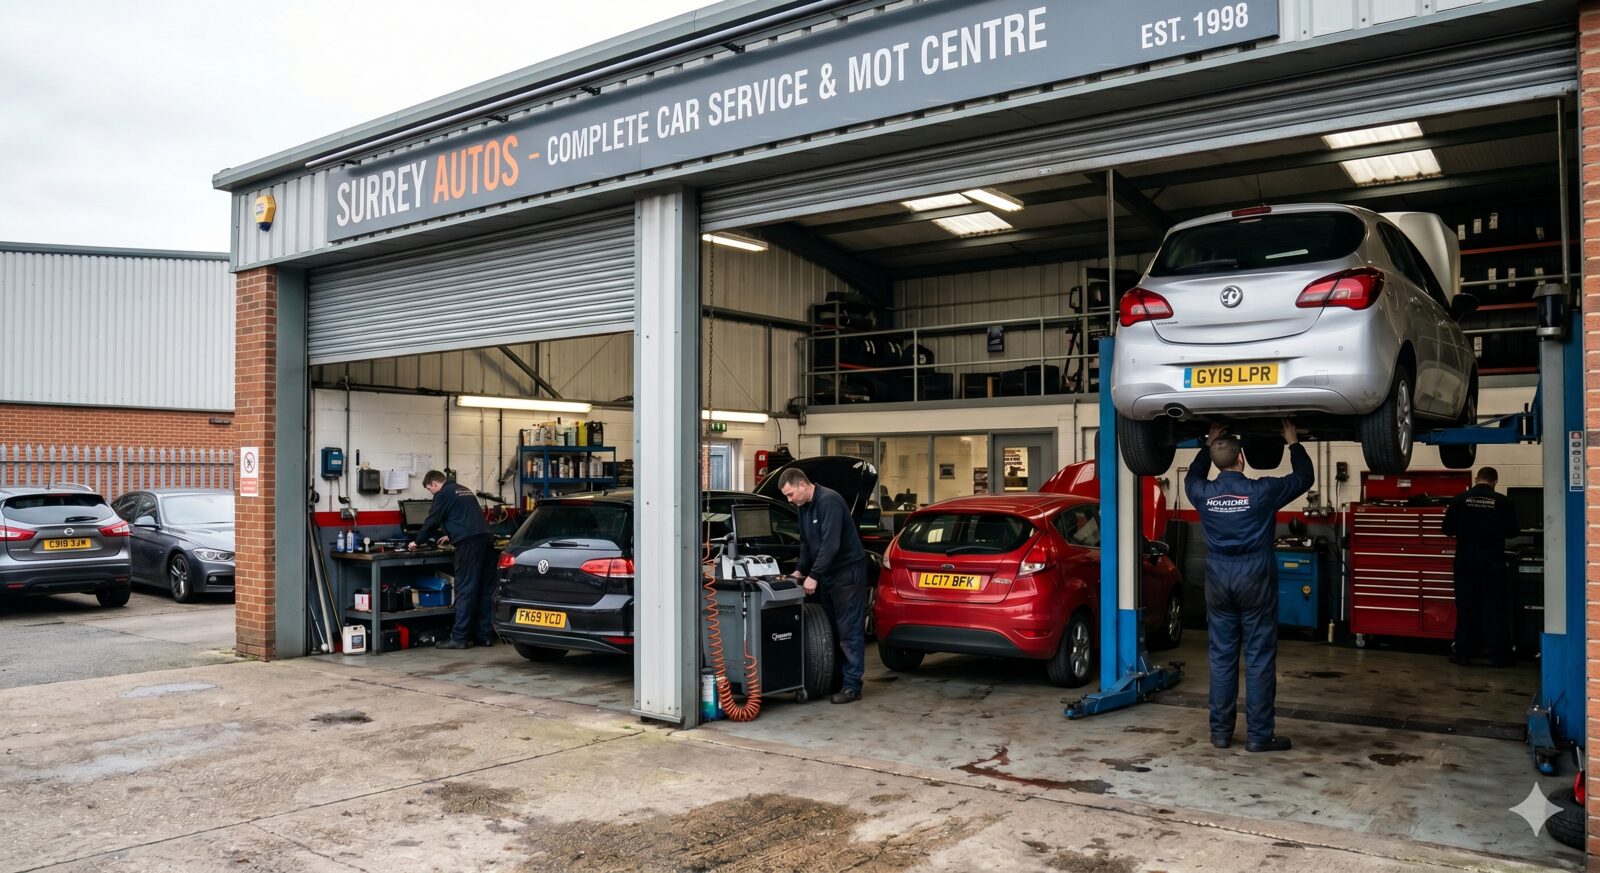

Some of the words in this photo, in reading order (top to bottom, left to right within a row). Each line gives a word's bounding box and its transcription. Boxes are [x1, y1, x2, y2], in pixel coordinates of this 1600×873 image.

[1141, 17, 1185, 49] EST.
[1193, 3, 1249, 36] 1998
[336, 160, 427, 227] SURREY
[433, 135, 519, 204] AUTOS
[528, 152, 540, 160] -
[547, 111, 649, 165] COMPLETE
[657, 99, 699, 138] CAR
[708, 69, 808, 126] SERVICE
[819, 63, 837, 99] &
[849, 42, 909, 93] MOT
[921, 7, 1047, 75] CENTRE
[1197, 368, 1233, 384] GY19
[1238, 366, 1271, 382] LPR
[924, 574, 950, 586] LC17
[952, 576, 974, 588] BFK
[519, 610, 542, 622] FK69
[544, 612, 561, 625] YCD
